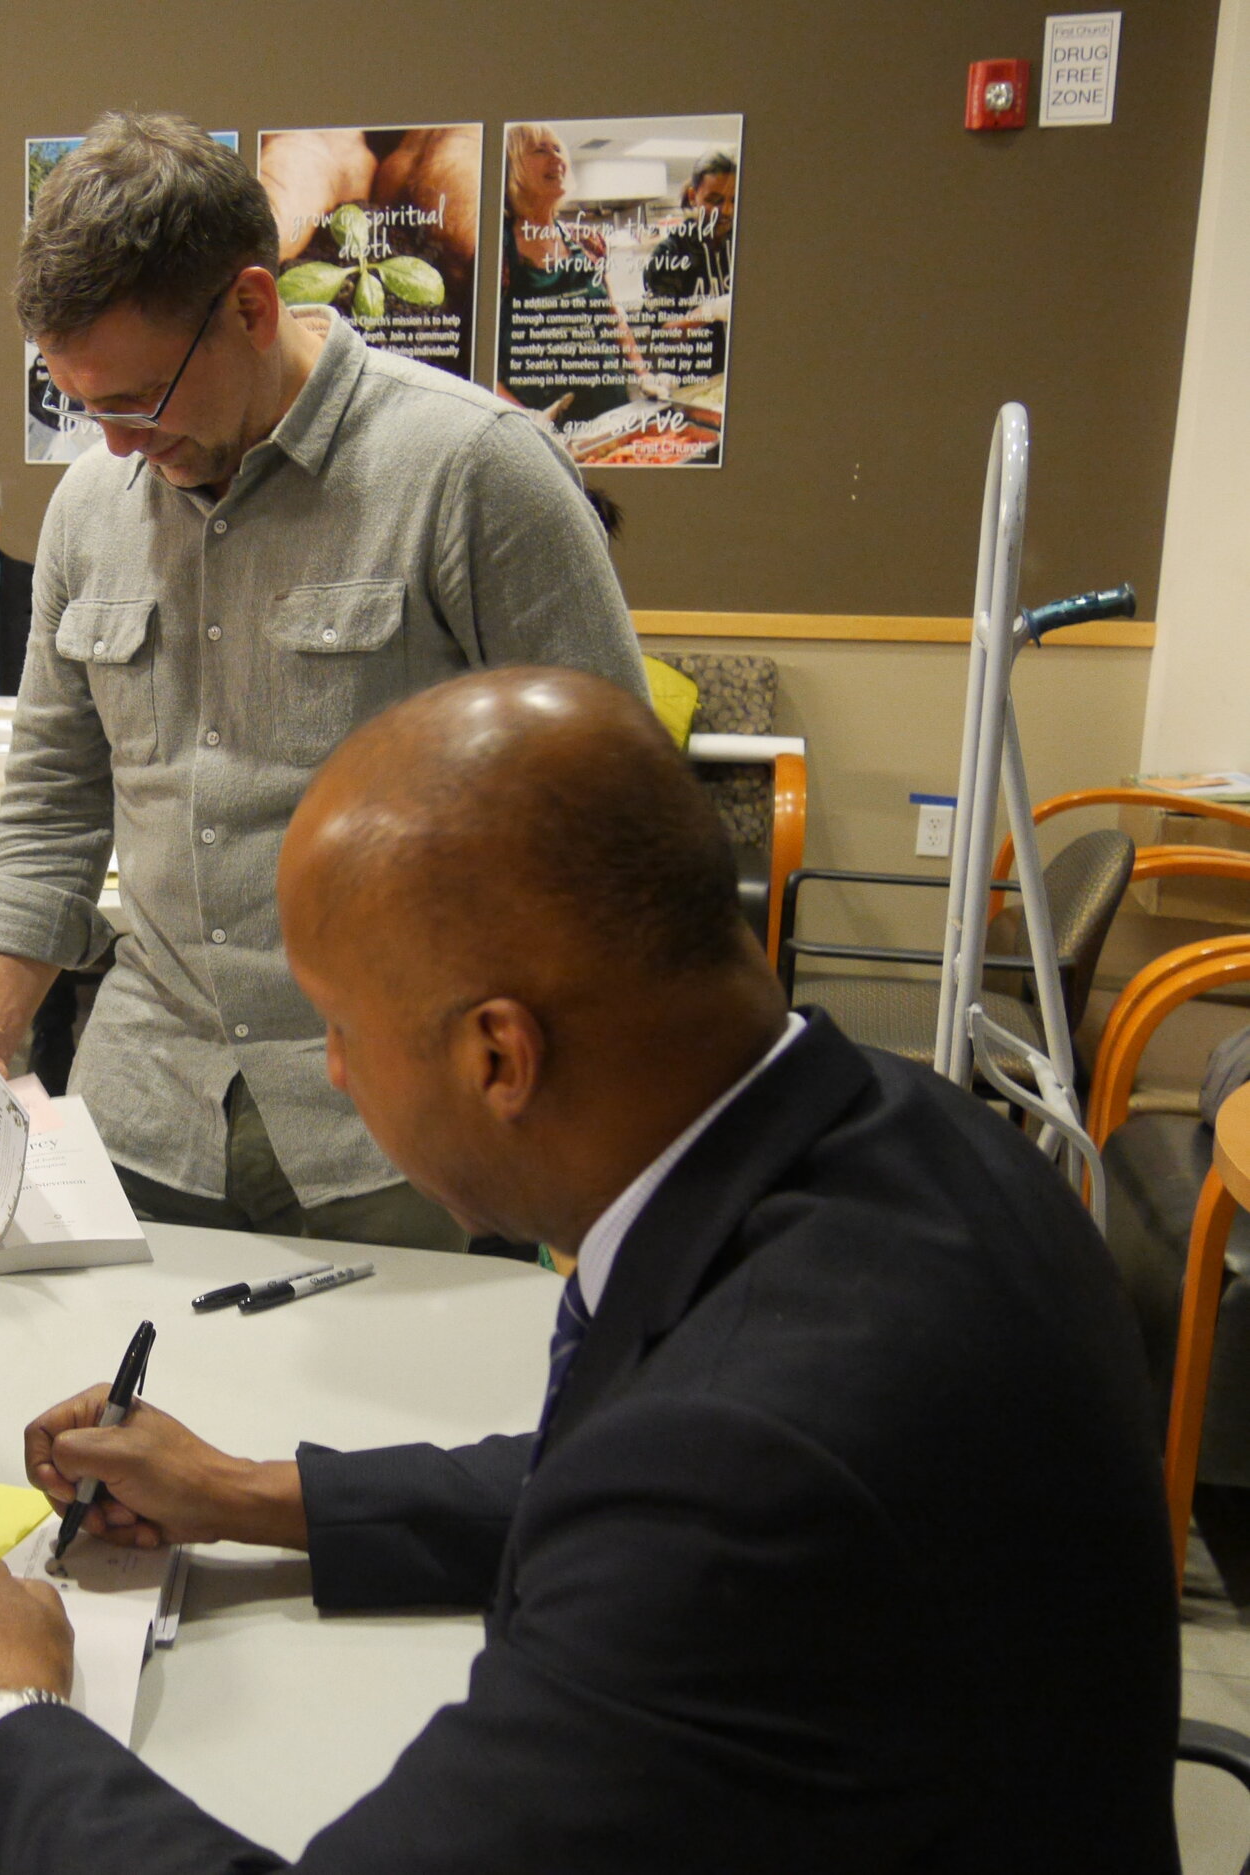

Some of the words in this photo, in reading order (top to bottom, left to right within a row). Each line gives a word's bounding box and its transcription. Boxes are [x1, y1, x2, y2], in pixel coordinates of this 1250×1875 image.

[1055, 26, 1074, 36] First
[1076, 24, 1109, 35] Church
[1053, 45, 1108, 63] DRUG
[1055, 67, 1103, 83] FREE
[1052, 88, 1103, 106] ZONE
[292, 209, 335, 242] grow
[365, 194, 445, 235] spiritual
[521, 210, 613, 241] transform
[625, 206, 656, 240] the
[662, 205, 718, 242] world
[338, 227, 392, 267] depth
[542, 241, 616, 287] through
[523, 298, 558, 309] addition
[560, 299, 570, 309] to
[572, 298, 587, 308] the
[432, 316, 442, 326] to
[442, 315, 461, 327] help
[511, 314, 545, 326] through
[546, 314, 592, 324] community
[642, 313, 657, 323] the
[414, 332, 460, 343] community
[511, 331, 526, 340] our
[529, 329, 568, 339] homeless
[651, 328, 683, 340] provide
[511, 344, 545, 356] monthly
[546, 343, 578, 356] Sunday
[650, 342, 694, 355] Fellowship
[696, 343, 713, 353] Hall
[510, 359, 523, 369] for
[525, 359, 559, 369] Seattle's
[561, 359, 600, 369] homeless
[602, 360, 619, 370] and
[657, 358, 676, 369] Find
[678, 358, 693, 372] joy
[695, 358, 712, 368] and
[510, 376, 545, 387] meaning
[555, 375, 568, 385] life
[568, 375, 601, 387] through
[633, 440, 658, 456] First
[660, 440, 708, 455] Church
[29, 1137, 59, 1151] rcy
